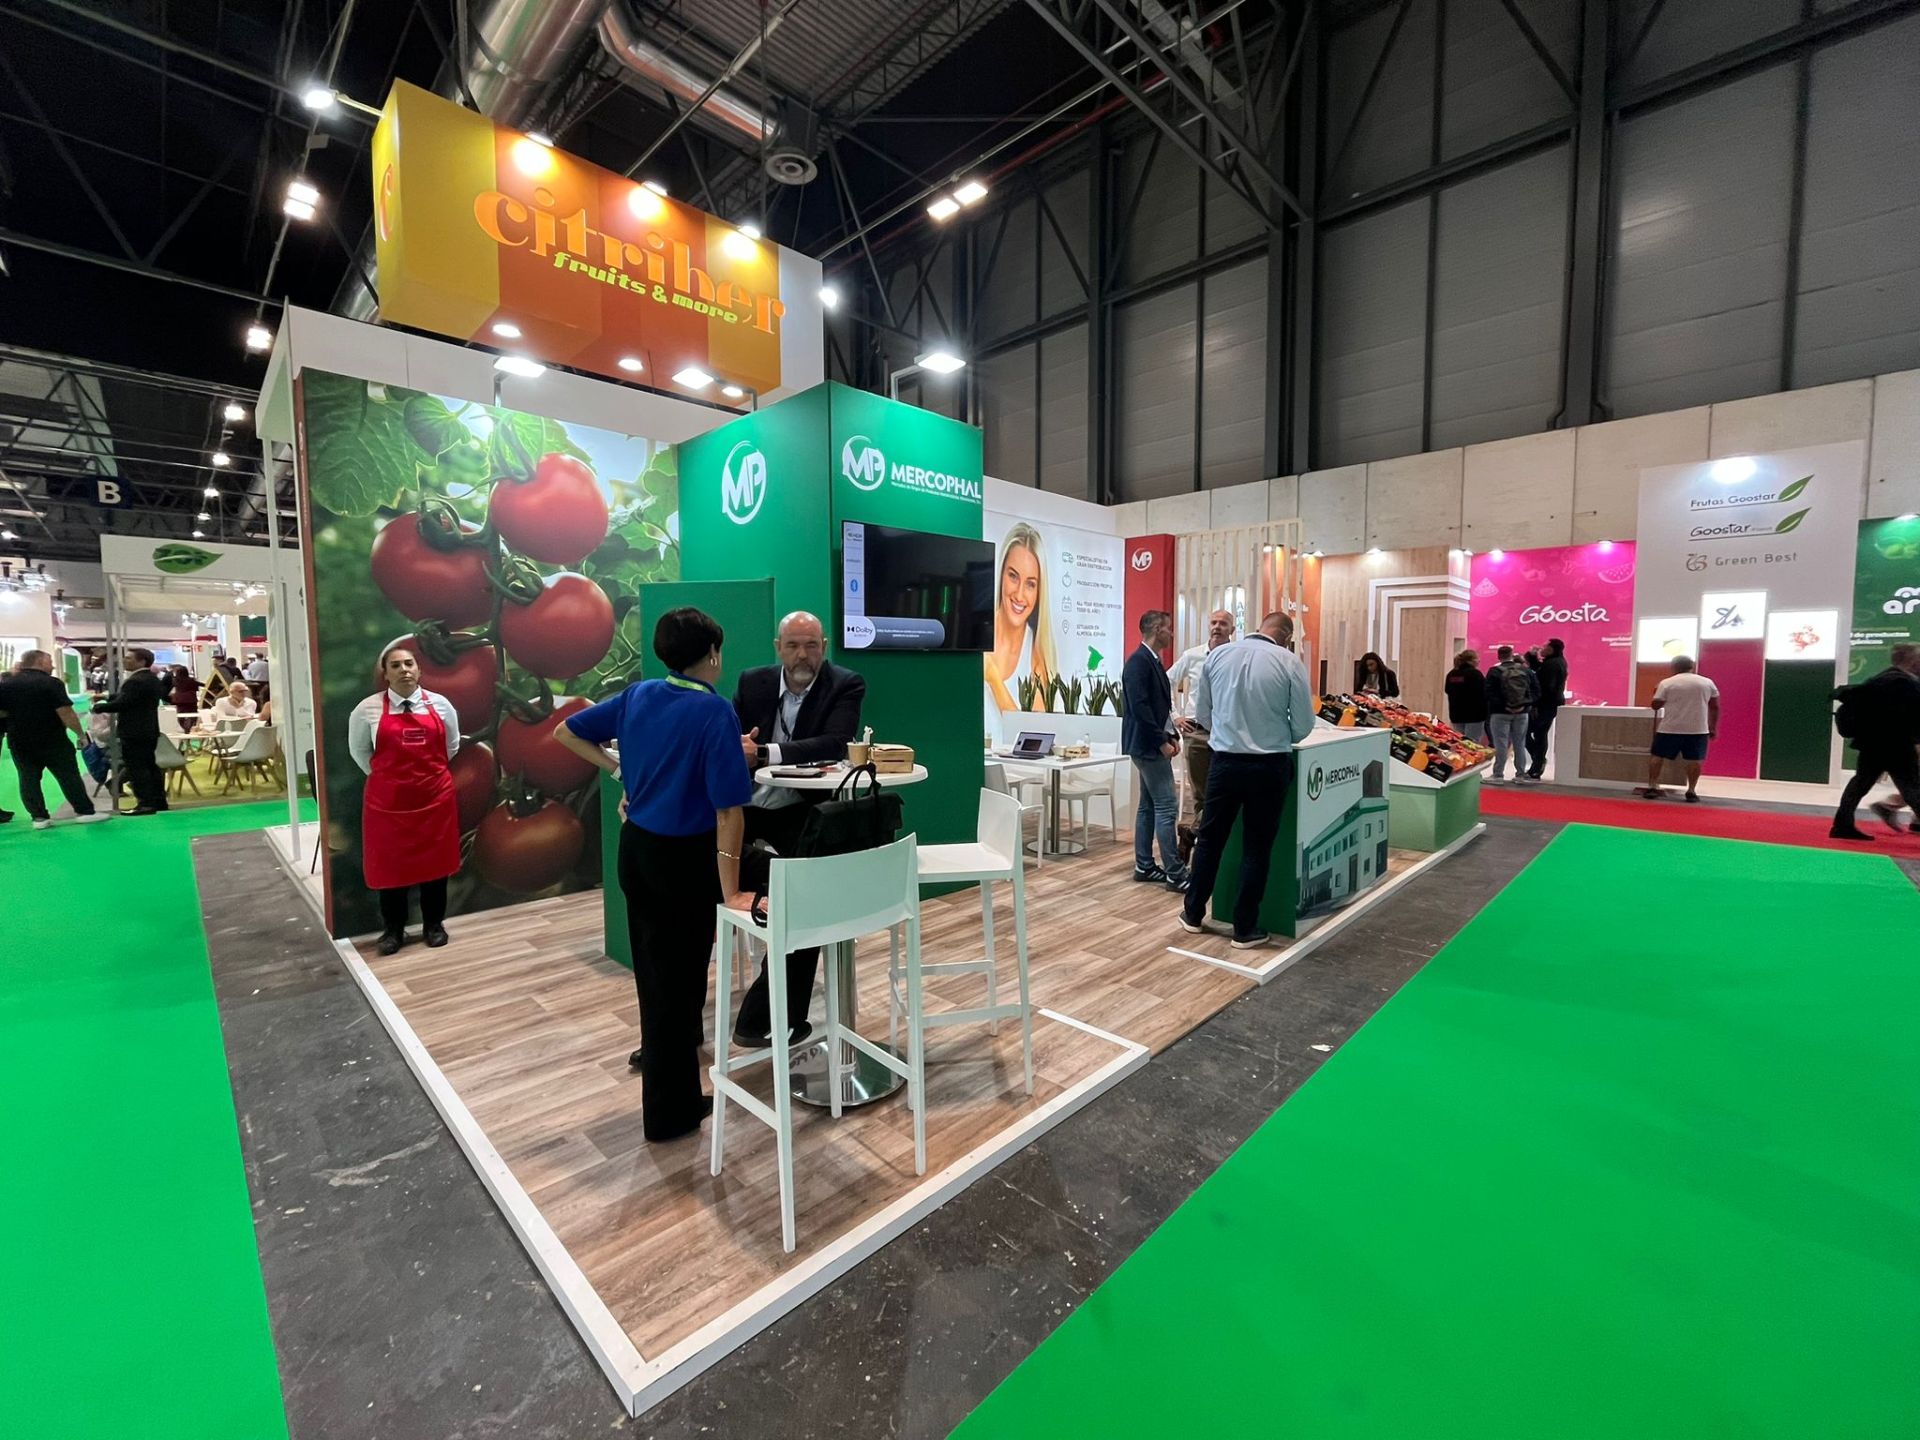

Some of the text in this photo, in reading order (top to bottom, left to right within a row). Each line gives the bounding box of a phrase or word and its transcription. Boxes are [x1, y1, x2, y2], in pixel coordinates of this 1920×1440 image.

[553, 252, 737, 323] fruits & more
[891, 462, 981, 499] MERCOPHAL
[97, 480, 121, 504] B
[1690, 493, 1776, 507] Frutas Goostar
[1690, 523, 1751, 537] Goostar
[1715, 556, 1757, 566] Green
[1764, 552, 1797, 563] Best
[855, 625, 873, 635] Dolby
[1325, 763, 1360, 786] MERCOPHAL
